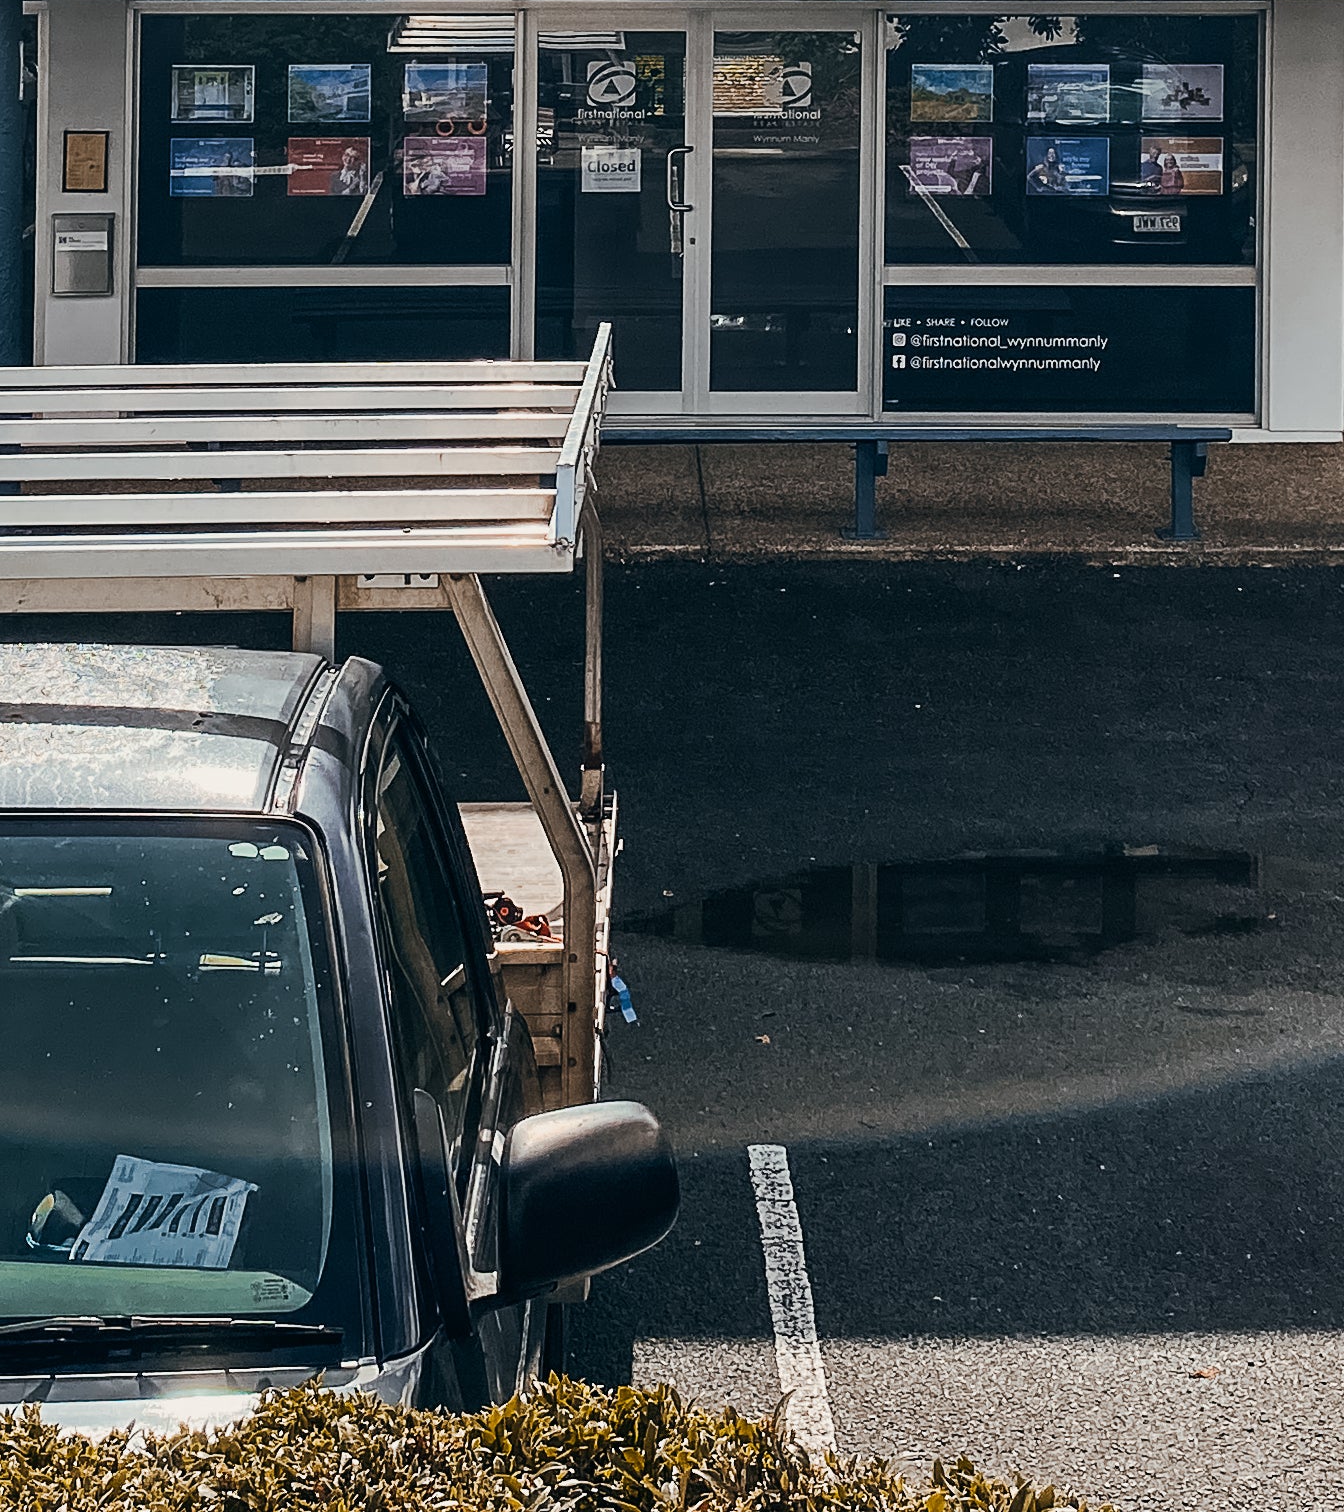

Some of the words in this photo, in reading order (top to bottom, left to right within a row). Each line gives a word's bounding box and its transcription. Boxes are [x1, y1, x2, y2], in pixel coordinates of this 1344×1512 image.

[587, 159, 636, 173] Closed
[893, 318, 912, 327] LIKE
[925, 318, 956, 327] SHARE
[970, 318, 1009, 327] FOLLOW
[909, 334, 1108, 350] @firstnational_wynnummanly
[909, 355, 1101, 372] @firstnationalwynnummanly
